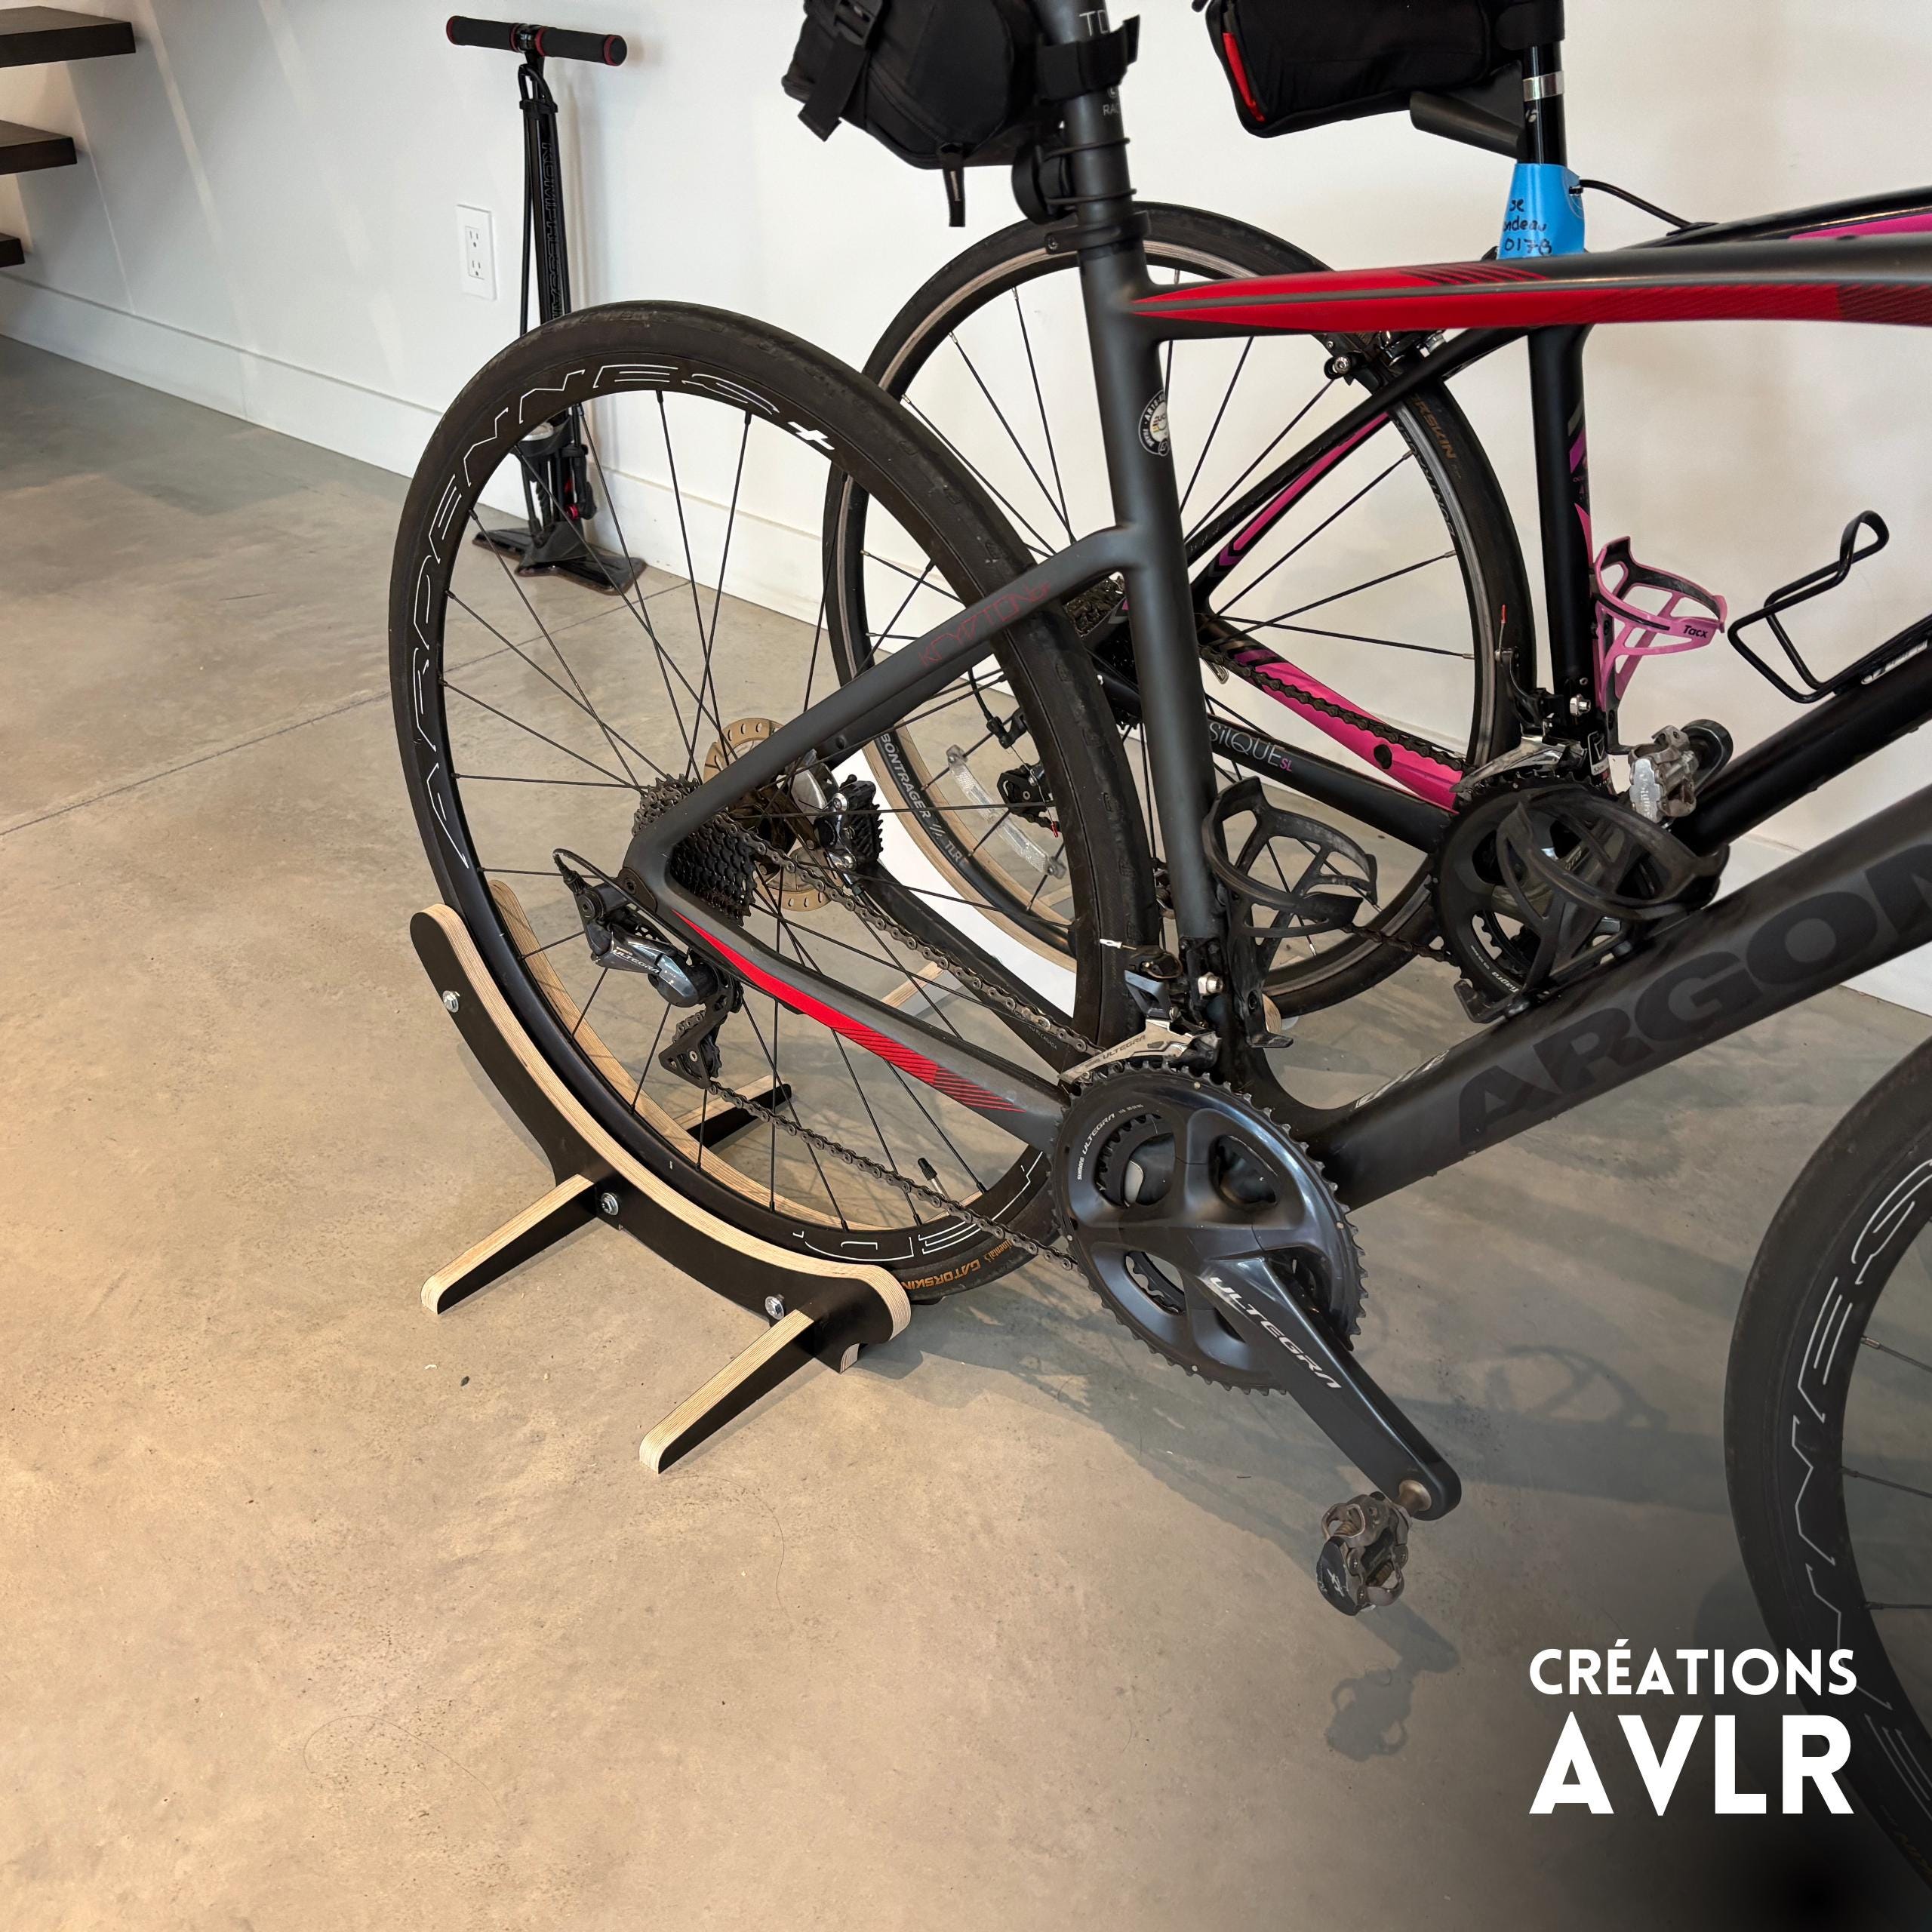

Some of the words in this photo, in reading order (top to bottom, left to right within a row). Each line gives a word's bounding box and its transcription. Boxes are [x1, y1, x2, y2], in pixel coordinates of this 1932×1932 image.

[1683, 624, 1709, 638] Tacx
[1280, 758, 1293, 771] SL
[881, 733, 931, 818] BONTRAGER
[943, 839, 963, 861] TLR
[1103, 1034, 1146, 1060] ULTEGRA
[1082, 1112, 1115, 1155] ULTEGRA
[902, 1259, 981, 1291] GATORSKIN
[1210, 1276, 1342, 1389] ULTEGRA
